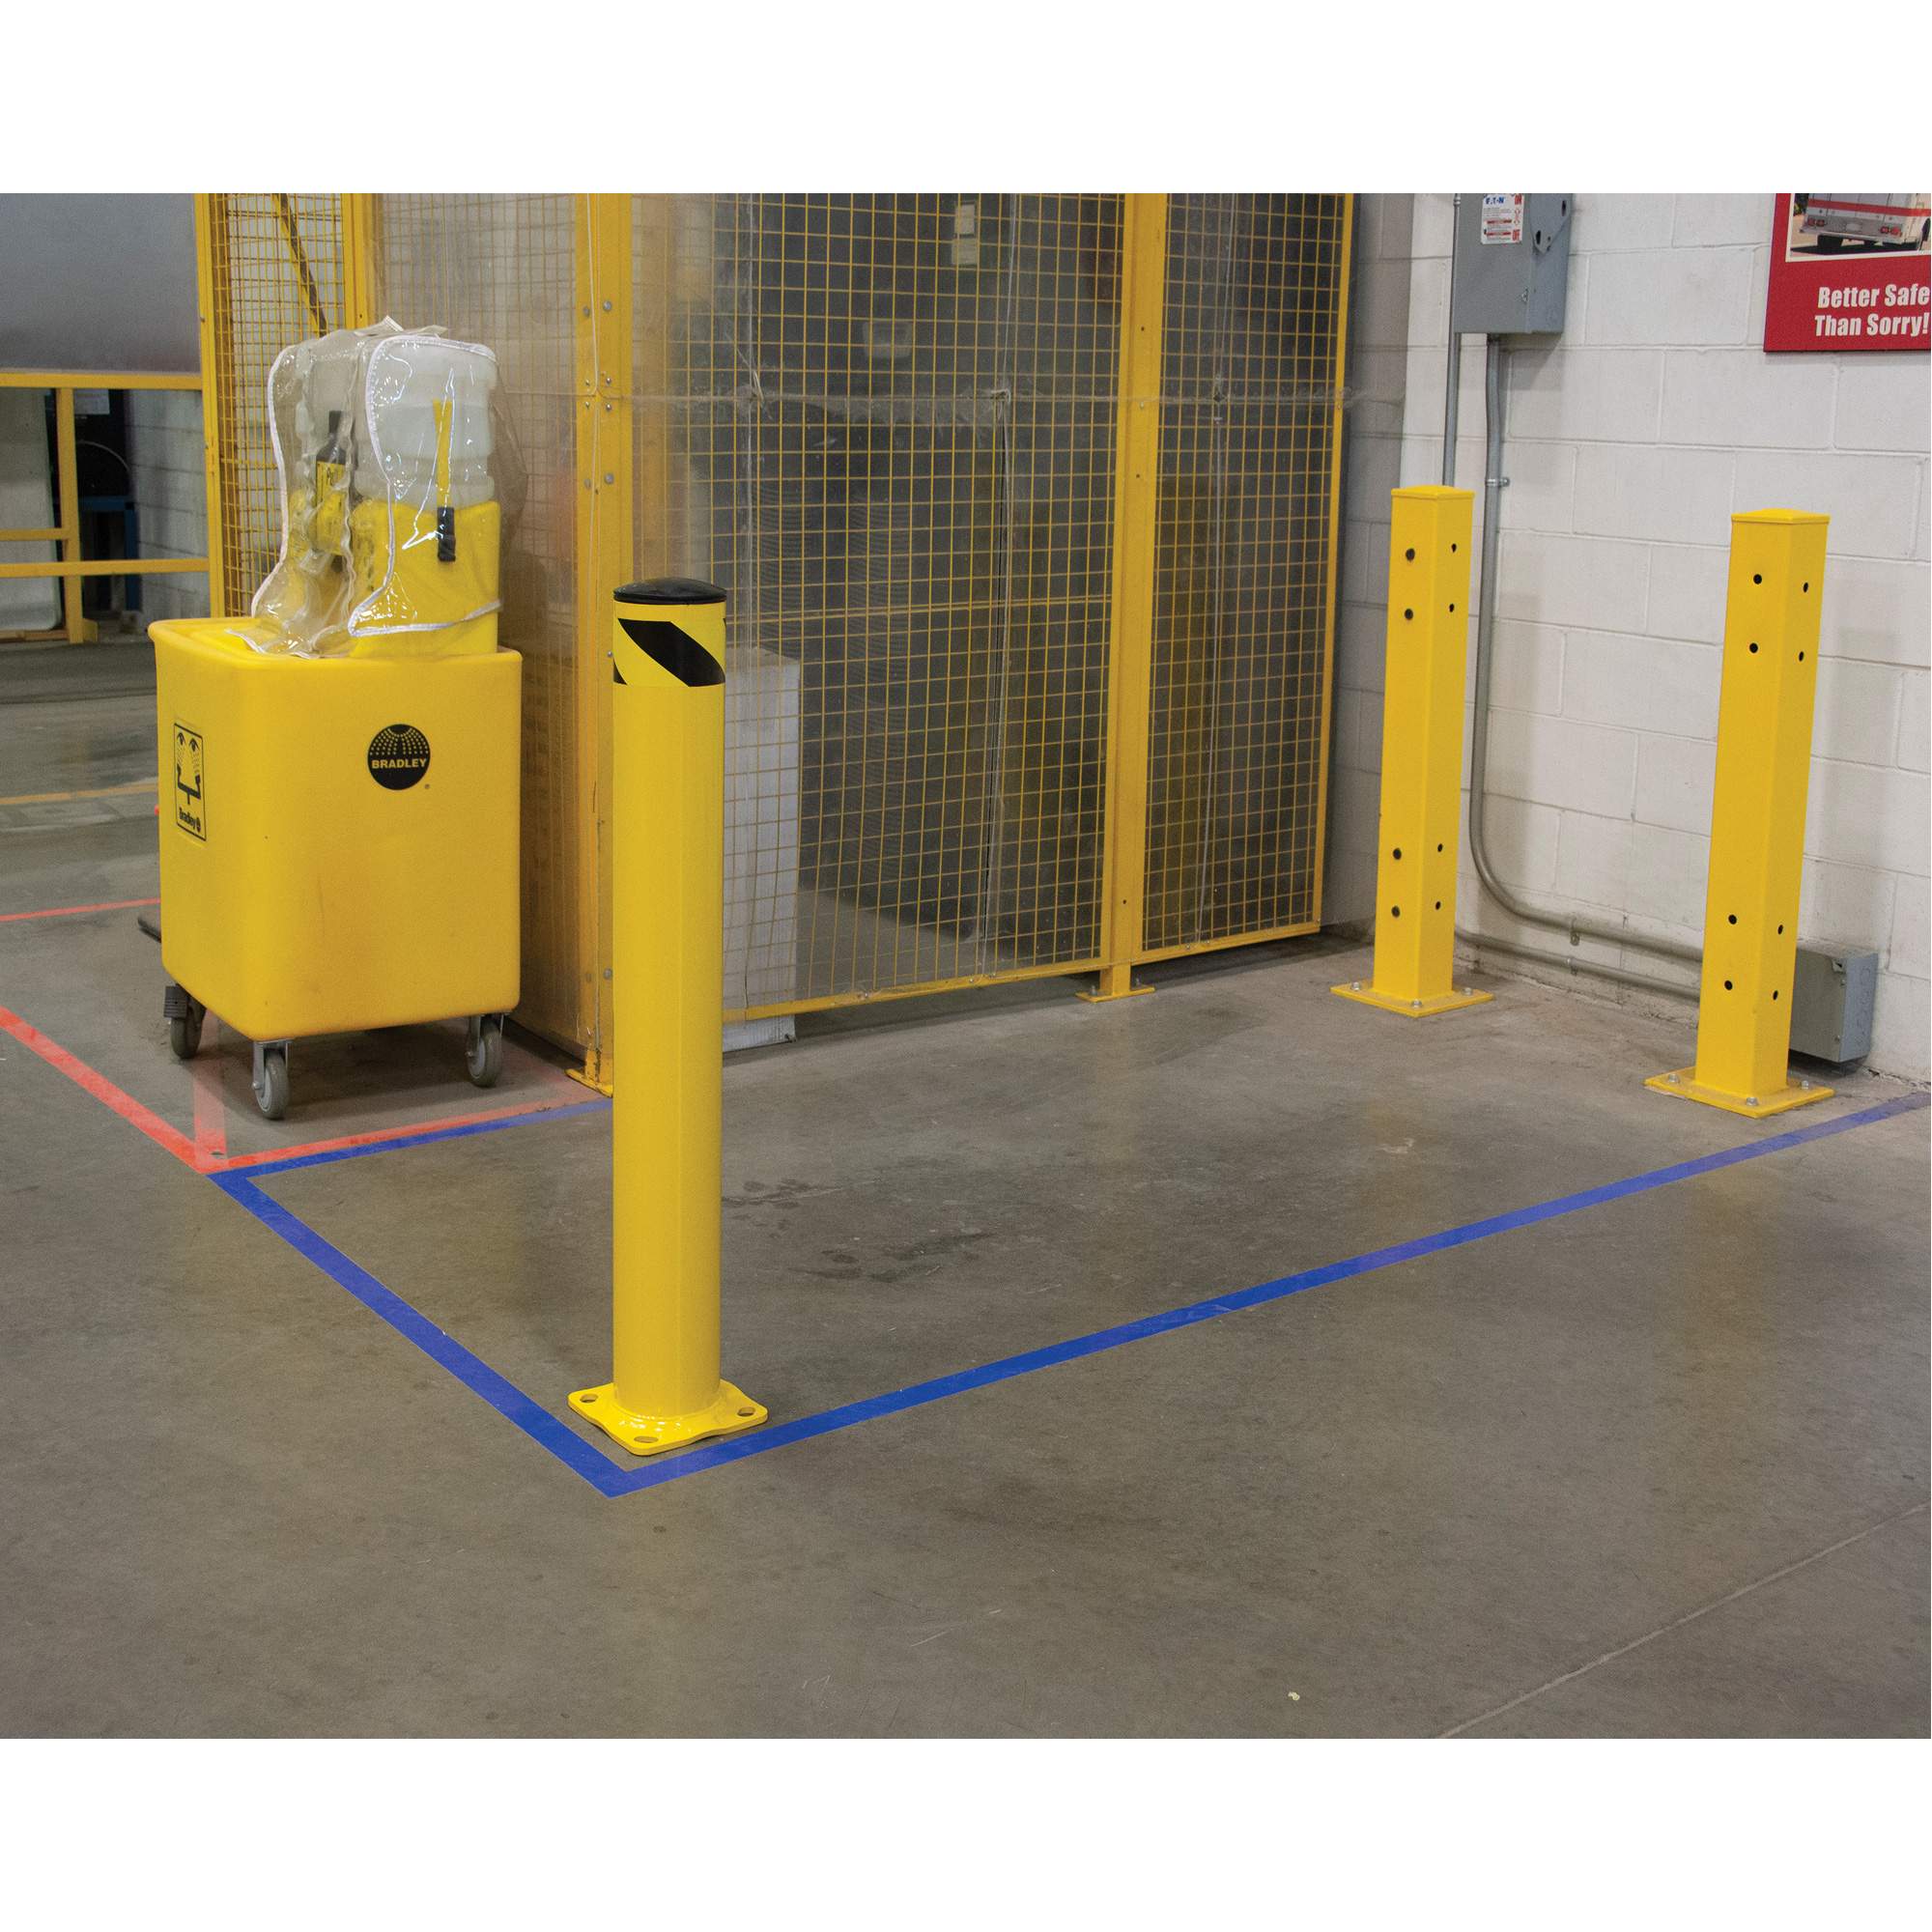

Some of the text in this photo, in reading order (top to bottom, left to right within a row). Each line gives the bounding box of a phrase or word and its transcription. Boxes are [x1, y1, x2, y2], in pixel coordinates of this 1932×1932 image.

[1817, 283, 1930, 309] Better Safe
[1814, 312, 1930, 337] Than Sorry!
[371, 758, 427, 769] BRADLEY
